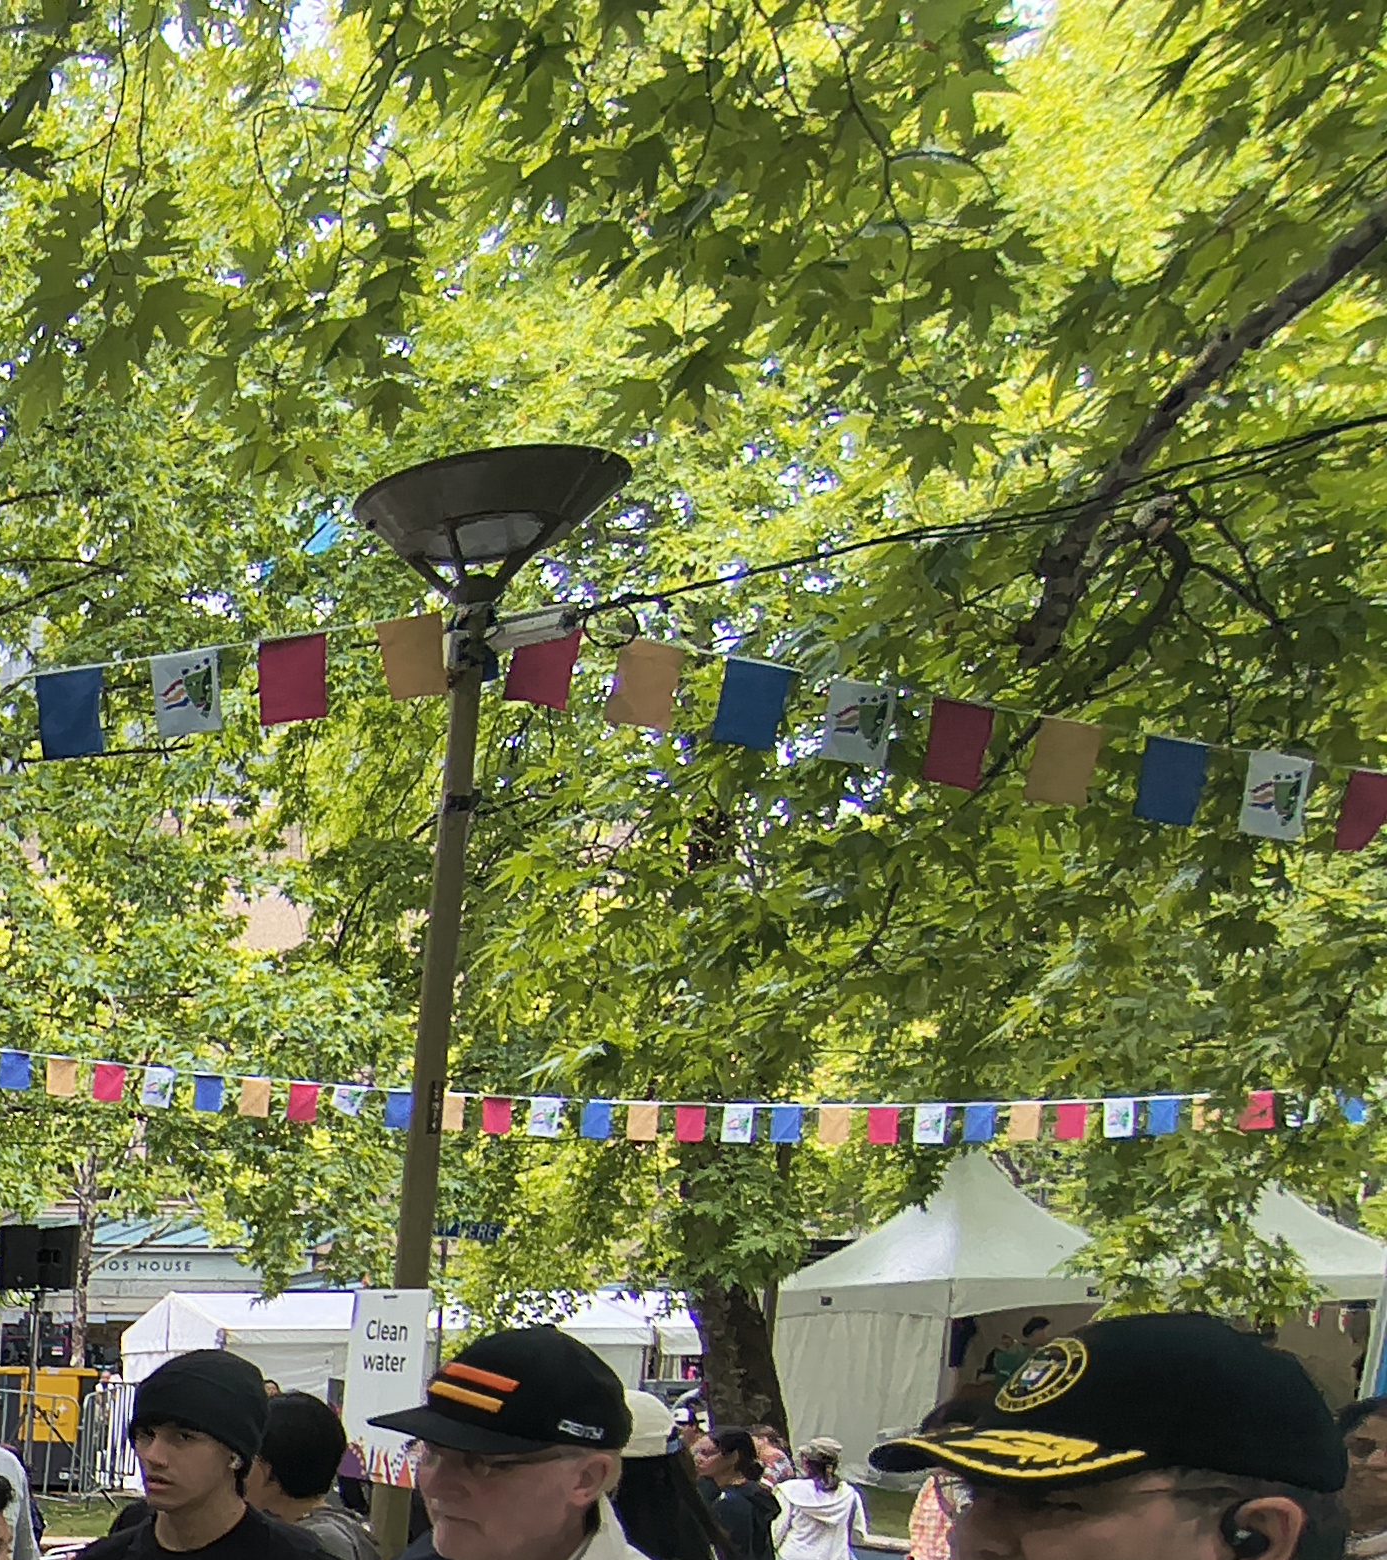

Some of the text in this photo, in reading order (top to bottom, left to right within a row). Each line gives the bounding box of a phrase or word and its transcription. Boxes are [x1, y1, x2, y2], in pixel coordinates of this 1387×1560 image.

[137, 1260, 192, 1272] HOUSE
[365, 1318, 409, 1342] Clean
[363, 1353, 407, 1373] water
